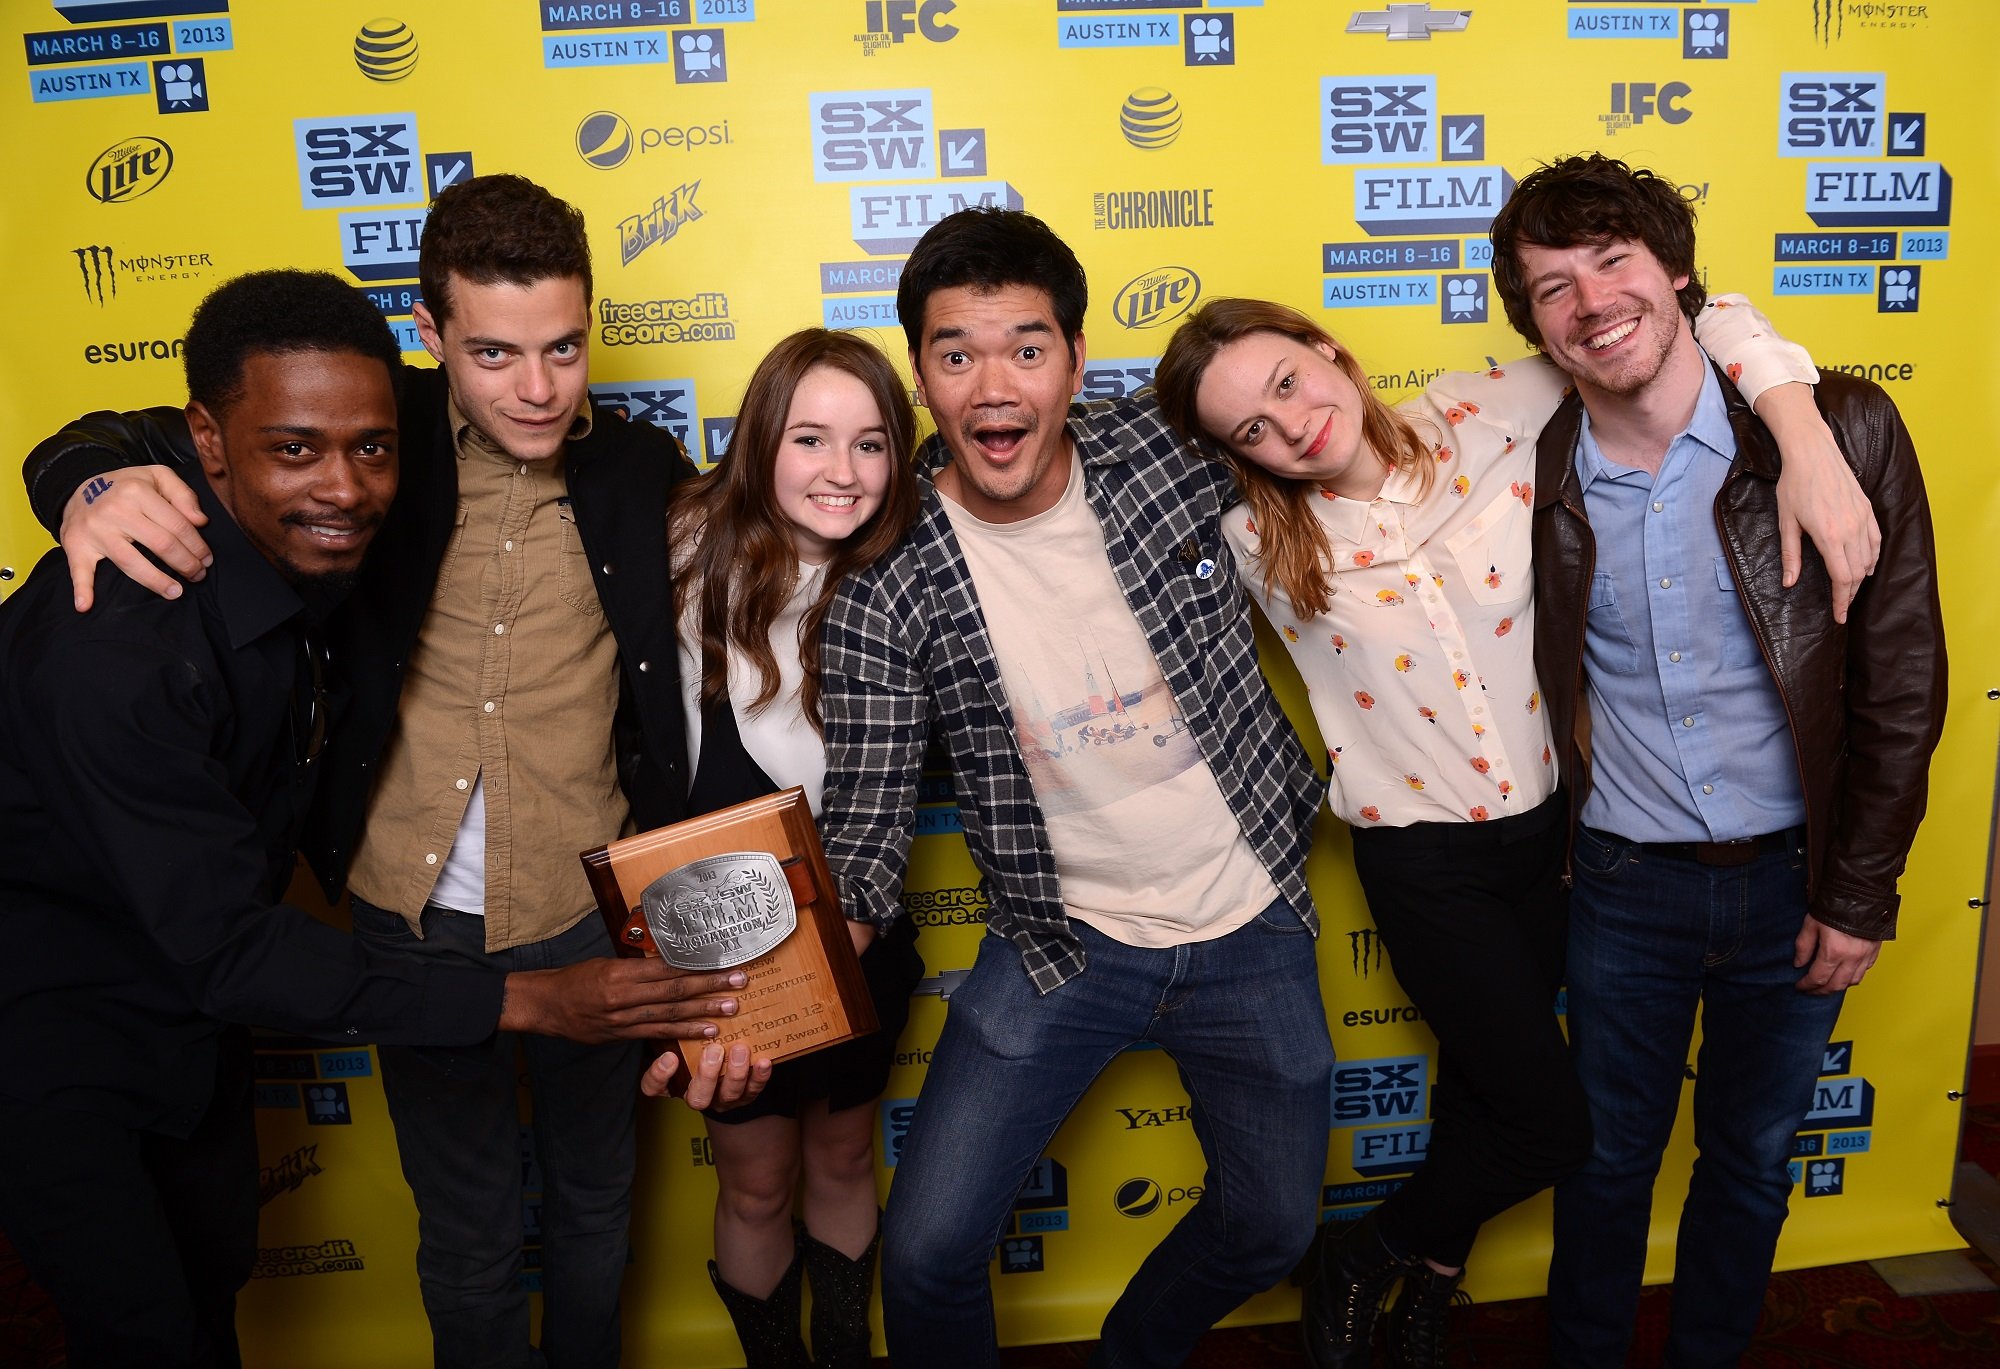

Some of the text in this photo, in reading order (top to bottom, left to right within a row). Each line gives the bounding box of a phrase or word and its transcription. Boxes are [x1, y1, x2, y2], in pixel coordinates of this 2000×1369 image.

[548, 3, 622, 23] MARCH
[703, 0, 748, 15] 2013
[866, 0, 960, 43] IFC
[1575, 15, 1671, 30] AUSTIN TX
[1848, 3, 1929, 19] MONSTER
[32, 36, 104, 57] MARCH
[181, 27, 226, 44] 2013
[853, 34, 879, 42] ALWAYS
[1066, 22, 1170, 40] AUSTIN TX
[551, 39, 660, 60] AUSTIN TX
[863, 41, 891, 49] SLIGHTLY
[39, 70, 142, 94] AUSTIN TX
[1330, 85, 1427, 117] SX
[1611, 81, 1693, 125] IFC
[1788, 83, 1877, 112] SX
[820, 100, 924, 134] SX
[306, 124, 409, 160] SX
[640, 120, 729, 154] pepsi
[1330, 122, 1427, 154] SW
[1787, 118, 1875, 147] SW
[108, 144, 141, 163] Miller
[823, 136, 924, 172] SW
[309, 161, 412, 198] SW
[1814, 172, 1931, 202] FILM
[1364, 177, 1492, 210] FILM
[1093, 193, 1106, 230] THE AUSTIN
[1106, 188, 1214, 230] CHRONICLE
[1330, 249, 1398, 266] MARCH
[1471, 246, 1492, 261] 20
[1781, 239, 1842, 255] MARCH
[1906, 239, 1943, 253] 2013
[120, 252, 214, 274] MONSTER
[136, 271, 201, 283] ENERGY
[829, 267, 900, 286] MARCH
[1137, 273, 1173, 290] Miller
[1780, 272, 1868, 288] AUSTIN TX
[1330, 282, 1429, 300] AUSTIN TX
[599, 293, 729, 324] freecredit
[601, 320, 736, 347] score.com
[84, 338, 185, 364] esuran
[697, 870, 717, 884] 2013
[679, 892, 761, 937] FILM
[691, 917, 763, 947] CHAMPION
[720, 937, 743, 954] XX
[747, 966, 782, 982] wards
[759, 972, 817, 997] FEATURE
[752, 1012, 800, 1033] Term
[801, 1002, 825, 1018] 12
[1343, 1006, 1425, 1027] esura
[752, 1022, 830, 1054] Jury Award
[325, 1056, 366, 1073] 2013
[1334, 1063, 1419, 1093] SX
[1334, 1090, 1419, 1121] SW
[1361, 1131, 1429, 1160] FIL
[1832, 1135, 1866, 1149] 2013
[1329, 1183, 1390, 1200] MARCH
[1026, 1214, 1063, 1228] 2013
[258, 1239, 356, 1263] eecredit
